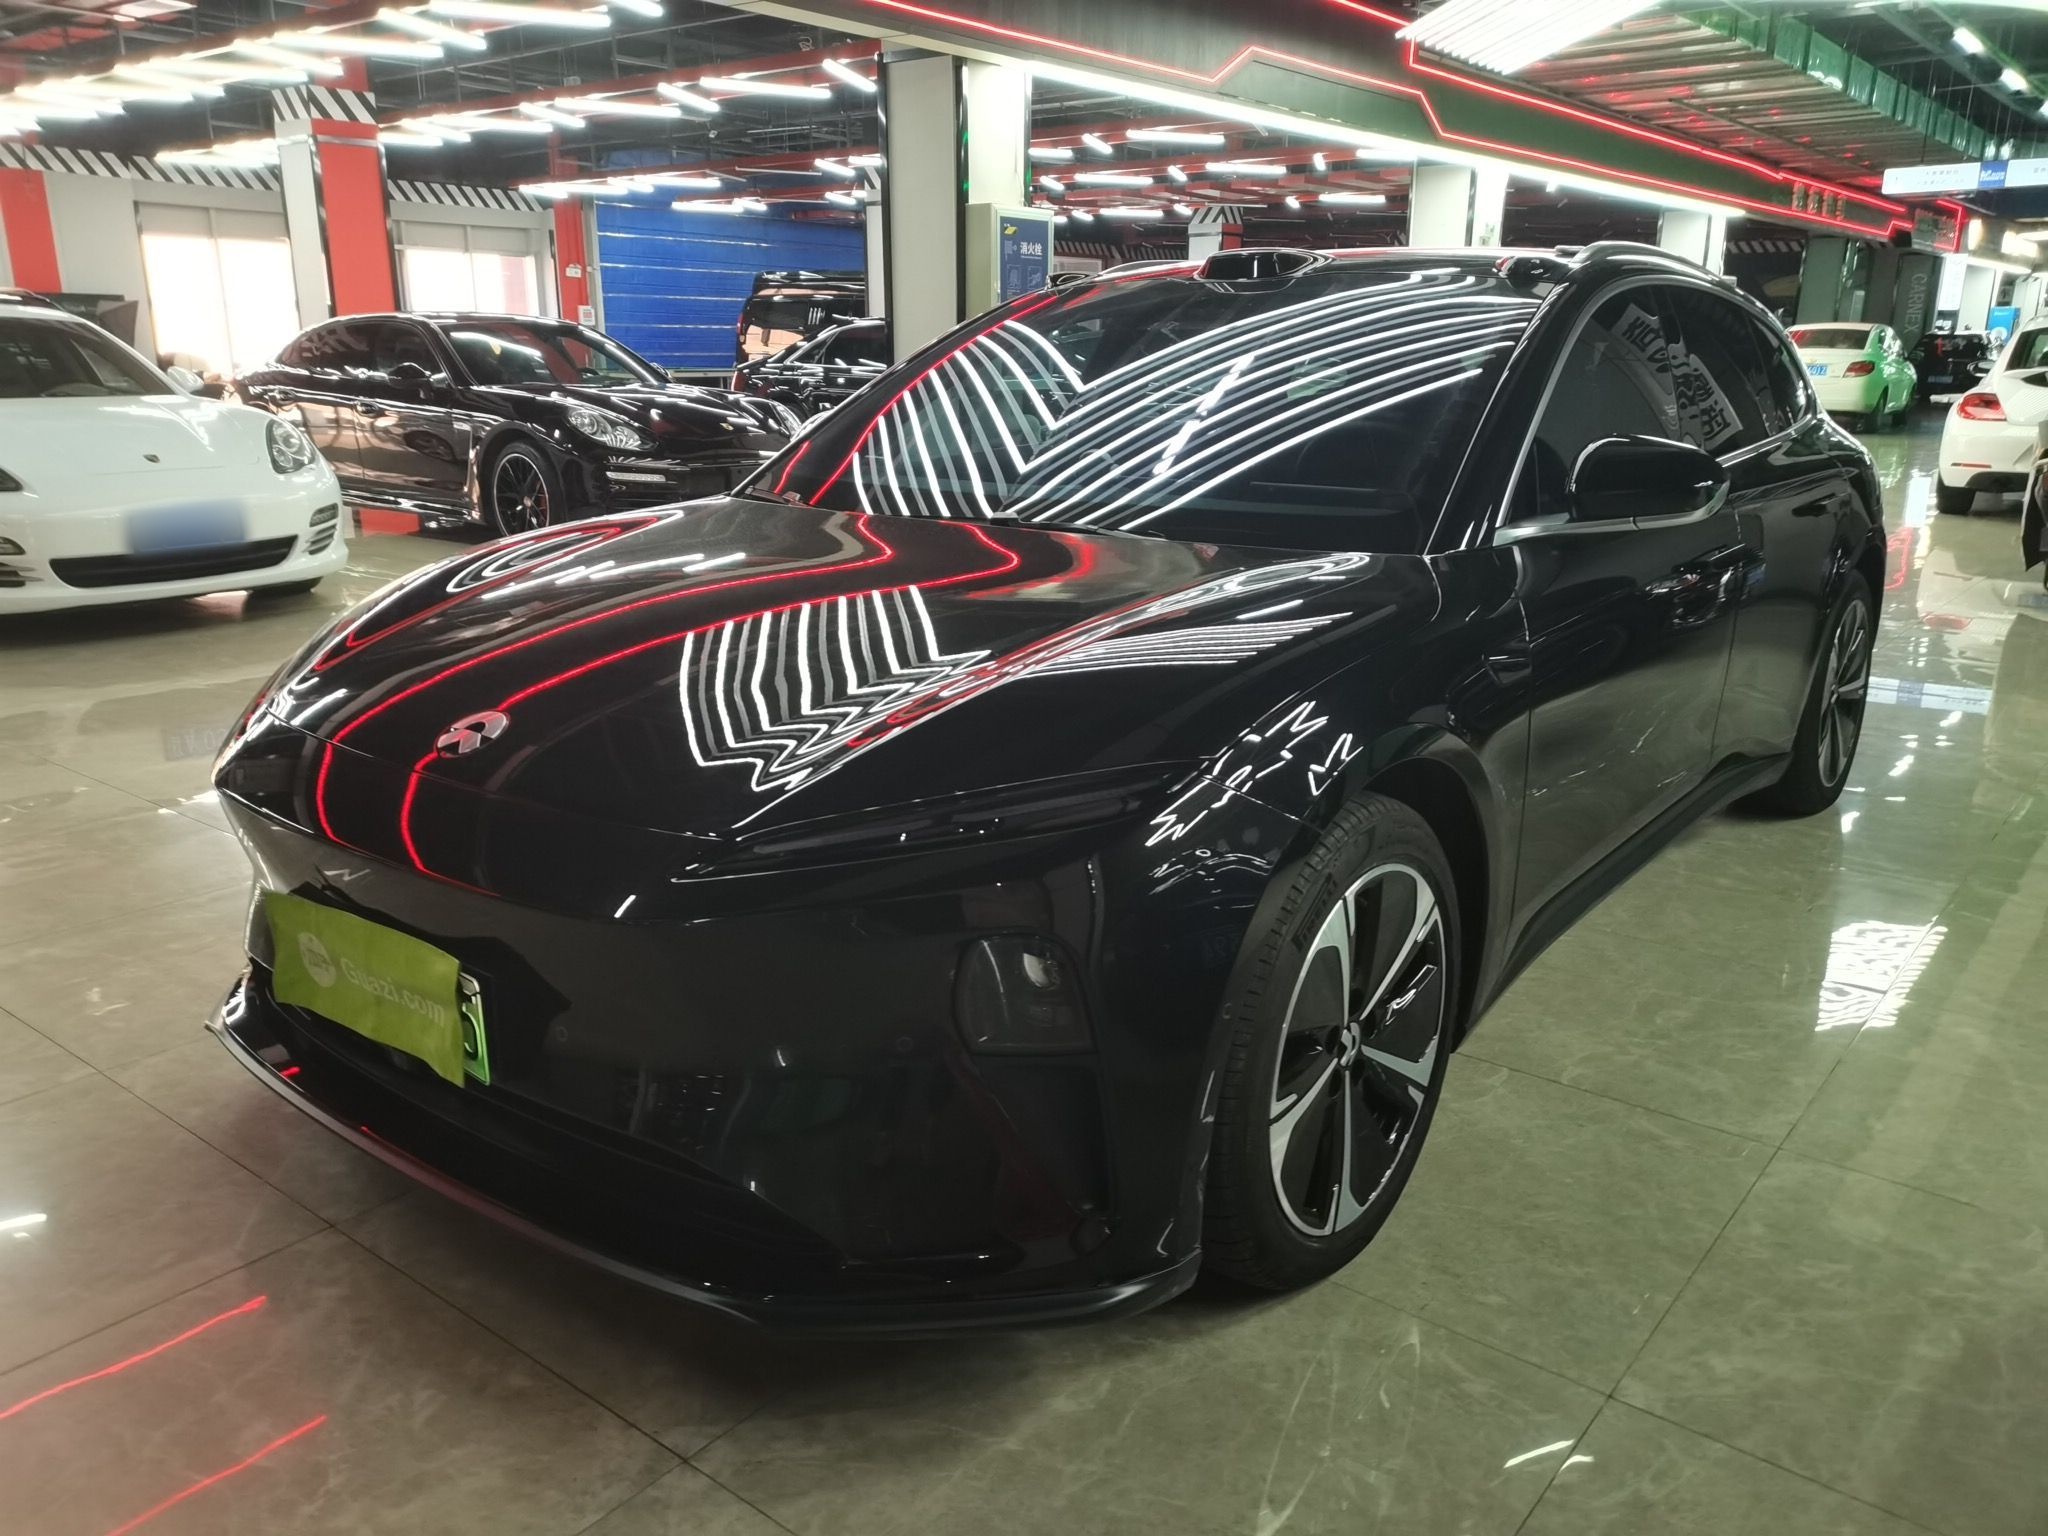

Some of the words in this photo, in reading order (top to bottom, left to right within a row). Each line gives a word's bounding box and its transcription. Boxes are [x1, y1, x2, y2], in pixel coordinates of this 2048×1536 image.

[1020, 241, 1042, 256] 消火栓
[1903, 274, 1928, 334] CARNEX
[340, 957, 444, 1028] Guazi.com
